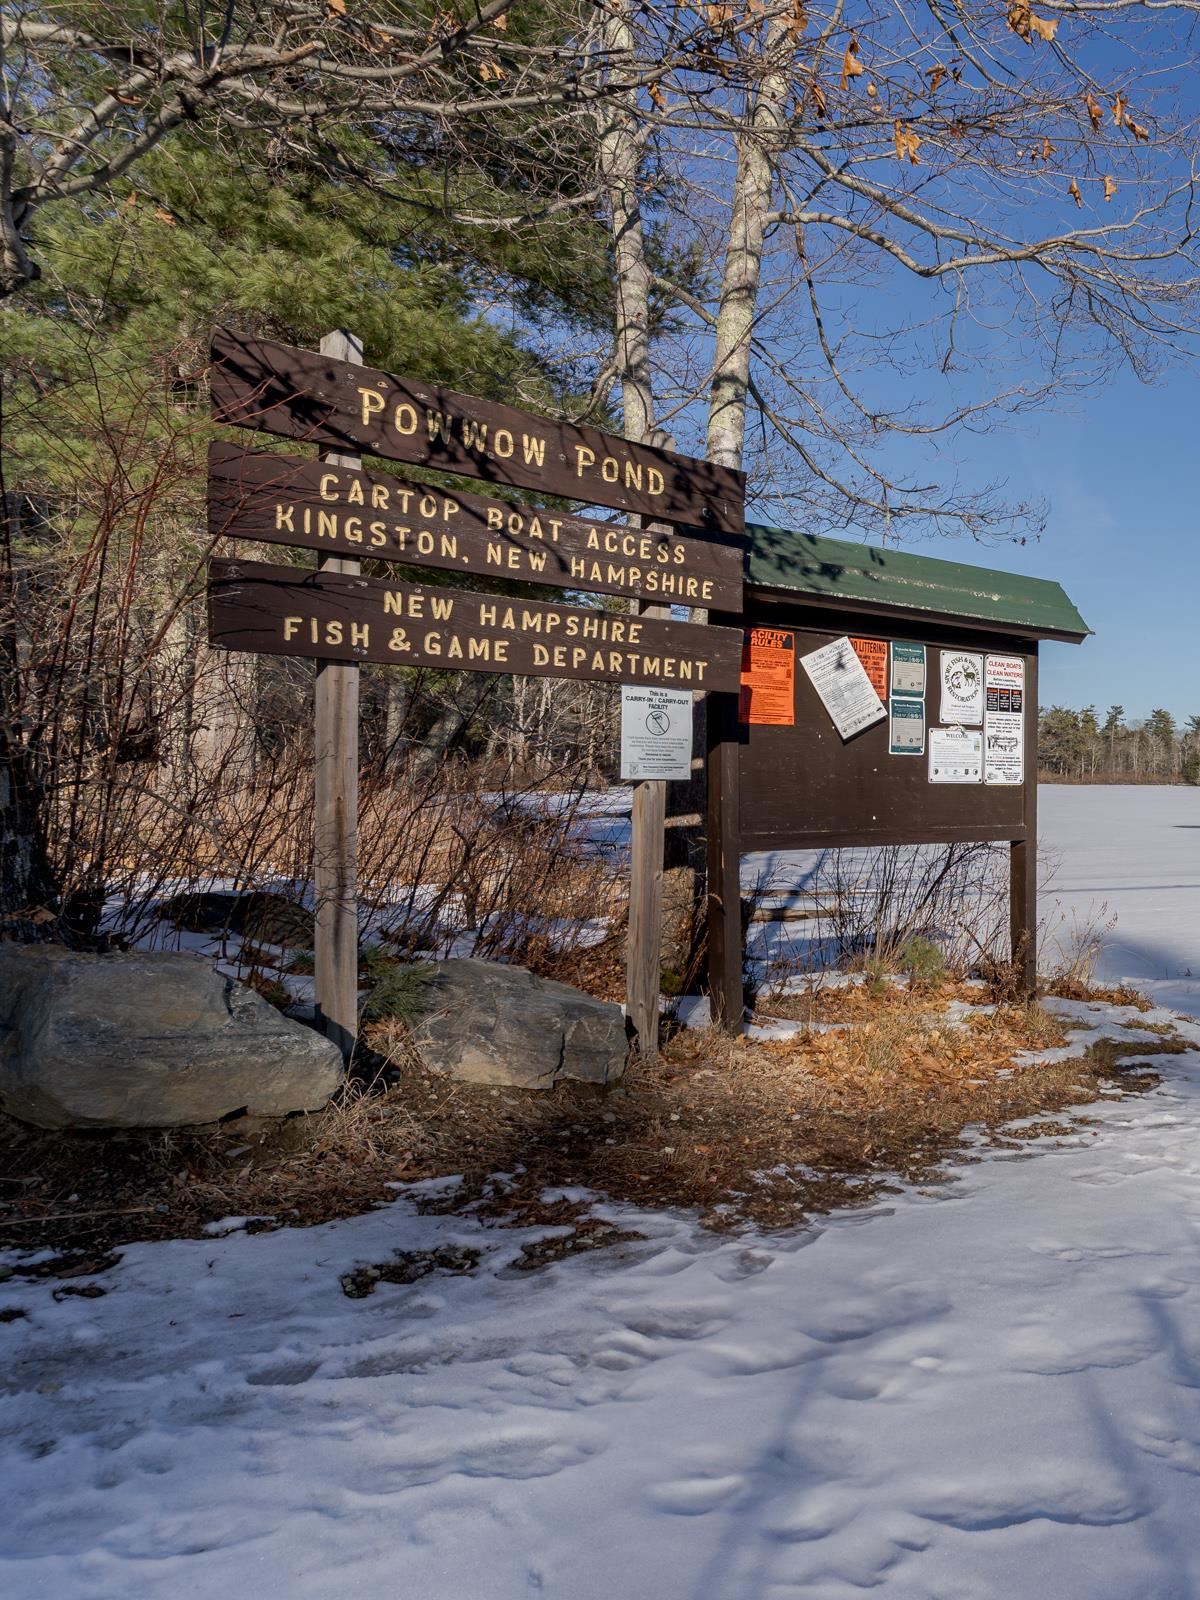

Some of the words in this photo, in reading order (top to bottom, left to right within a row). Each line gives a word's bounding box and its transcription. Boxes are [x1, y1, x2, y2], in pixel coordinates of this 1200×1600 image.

[358, 387, 547, 467] POWWOW
[574, 445, 667, 496] POND
[320, 474, 461, 522] CARTOP
[487, 507, 563, 541] BOAT
[586, 528, 686, 565] ACCESS
[275, 504, 470, 565] KINGSTON,
[487, 543, 548, 572] NEW
[571, 558, 714, 601] HAMPSHIRE
[384, 590, 455, 621] NEW
[479, 605, 644, 644] HAMPSHIRE
[750, 630, 788, 641] ACILITY
[751, 638, 783, 648] RULES
[283, 616, 370, 648] FISH
[387, 627, 412, 653] &
[423, 632, 509, 663] GAME
[533, 645, 709, 681] DEPARTMENT
[859, 641, 886, 654] LITTERING
[950, 656, 964, 666] FISH
[1006, 662, 1022, 670] BOATS
[625, 695, 654, 703] CARRY-IN
[658, 697, 689, 705] CARRY-OUT
[947, 685, 979, 702] RESTORATION
